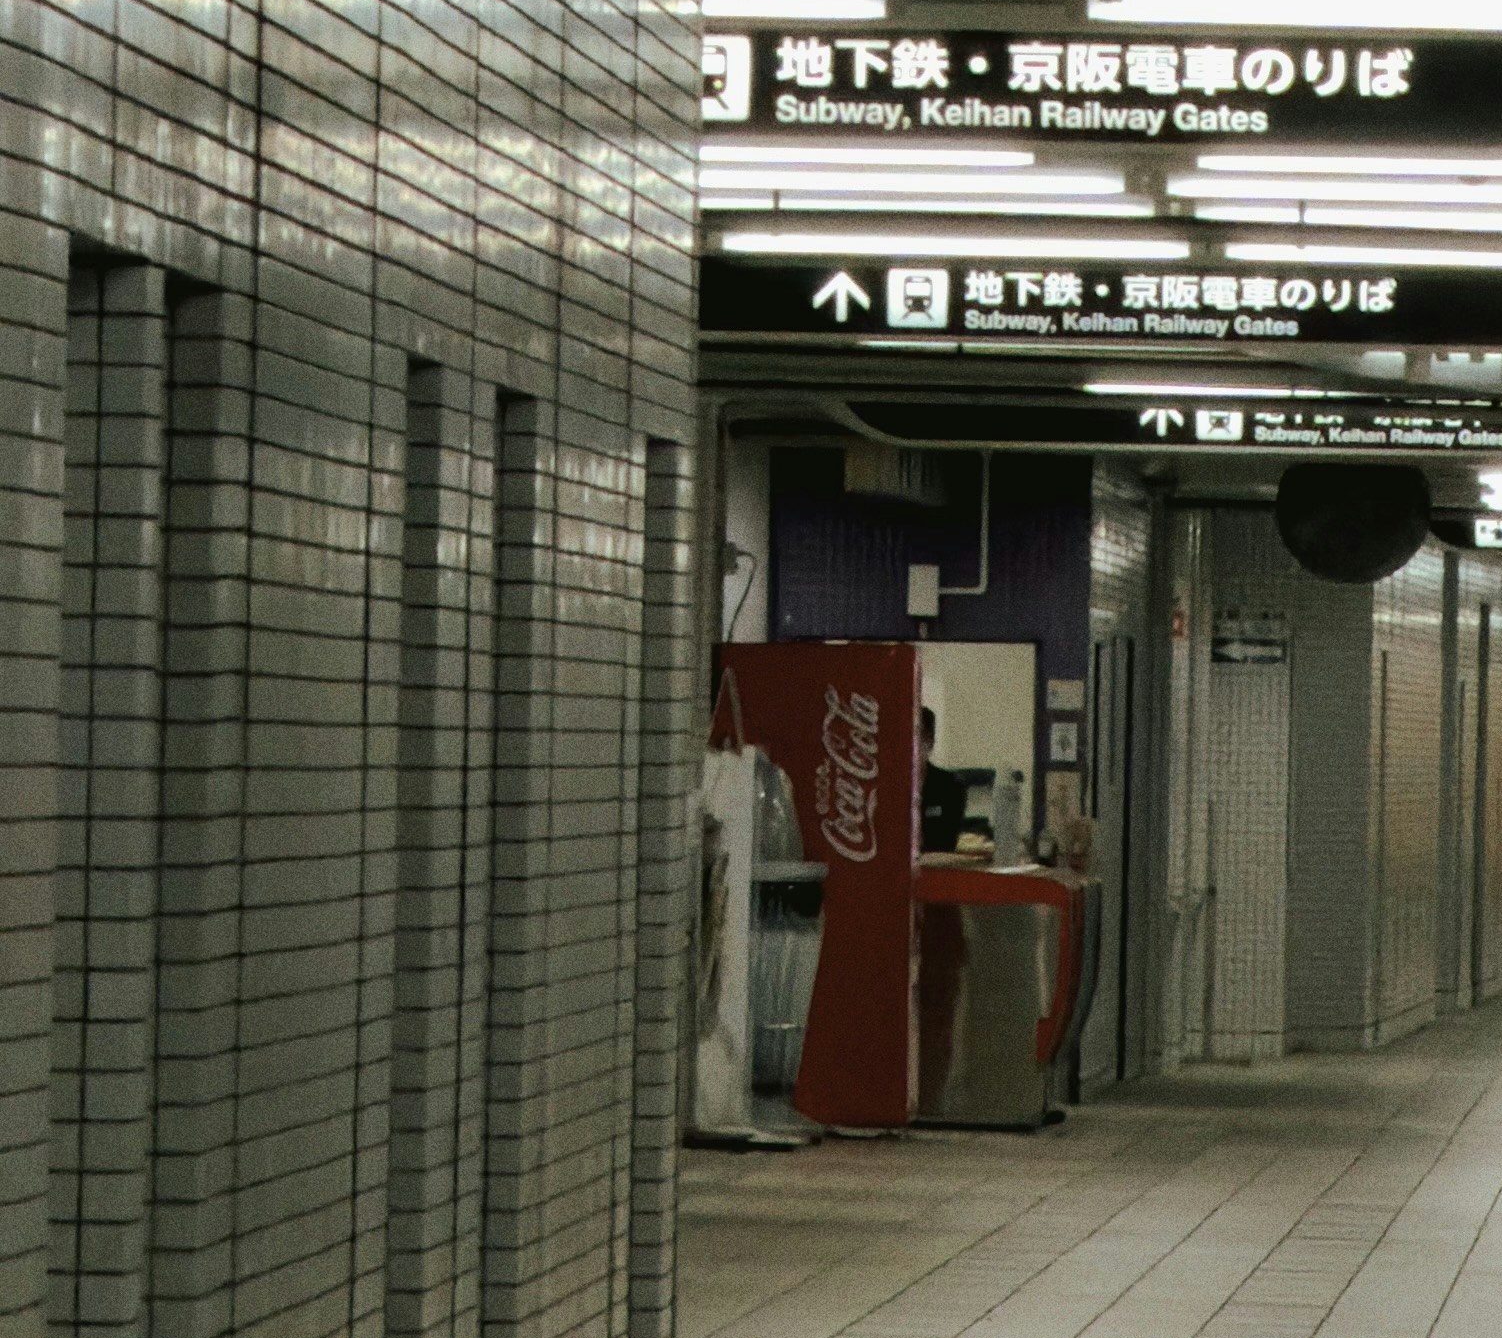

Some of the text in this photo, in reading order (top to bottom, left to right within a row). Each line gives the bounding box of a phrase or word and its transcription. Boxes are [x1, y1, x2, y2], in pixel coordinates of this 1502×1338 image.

[775, 37, 1414, 97] 地下鉄・京阪電車のりば
[775, 94, 1268, 135] Subway, Keihan Railway Gates
[965, 270, 1396, 312] 地下鉄・京阪電車のりば
[964, 309, 1299, 337] Subway, Keihan Railway Gates
[1329, 427, 1386, 443] Keihan
[1390, 428, 1455, 447] Railway
[821, 683, 880, 862] Coca-Cola
